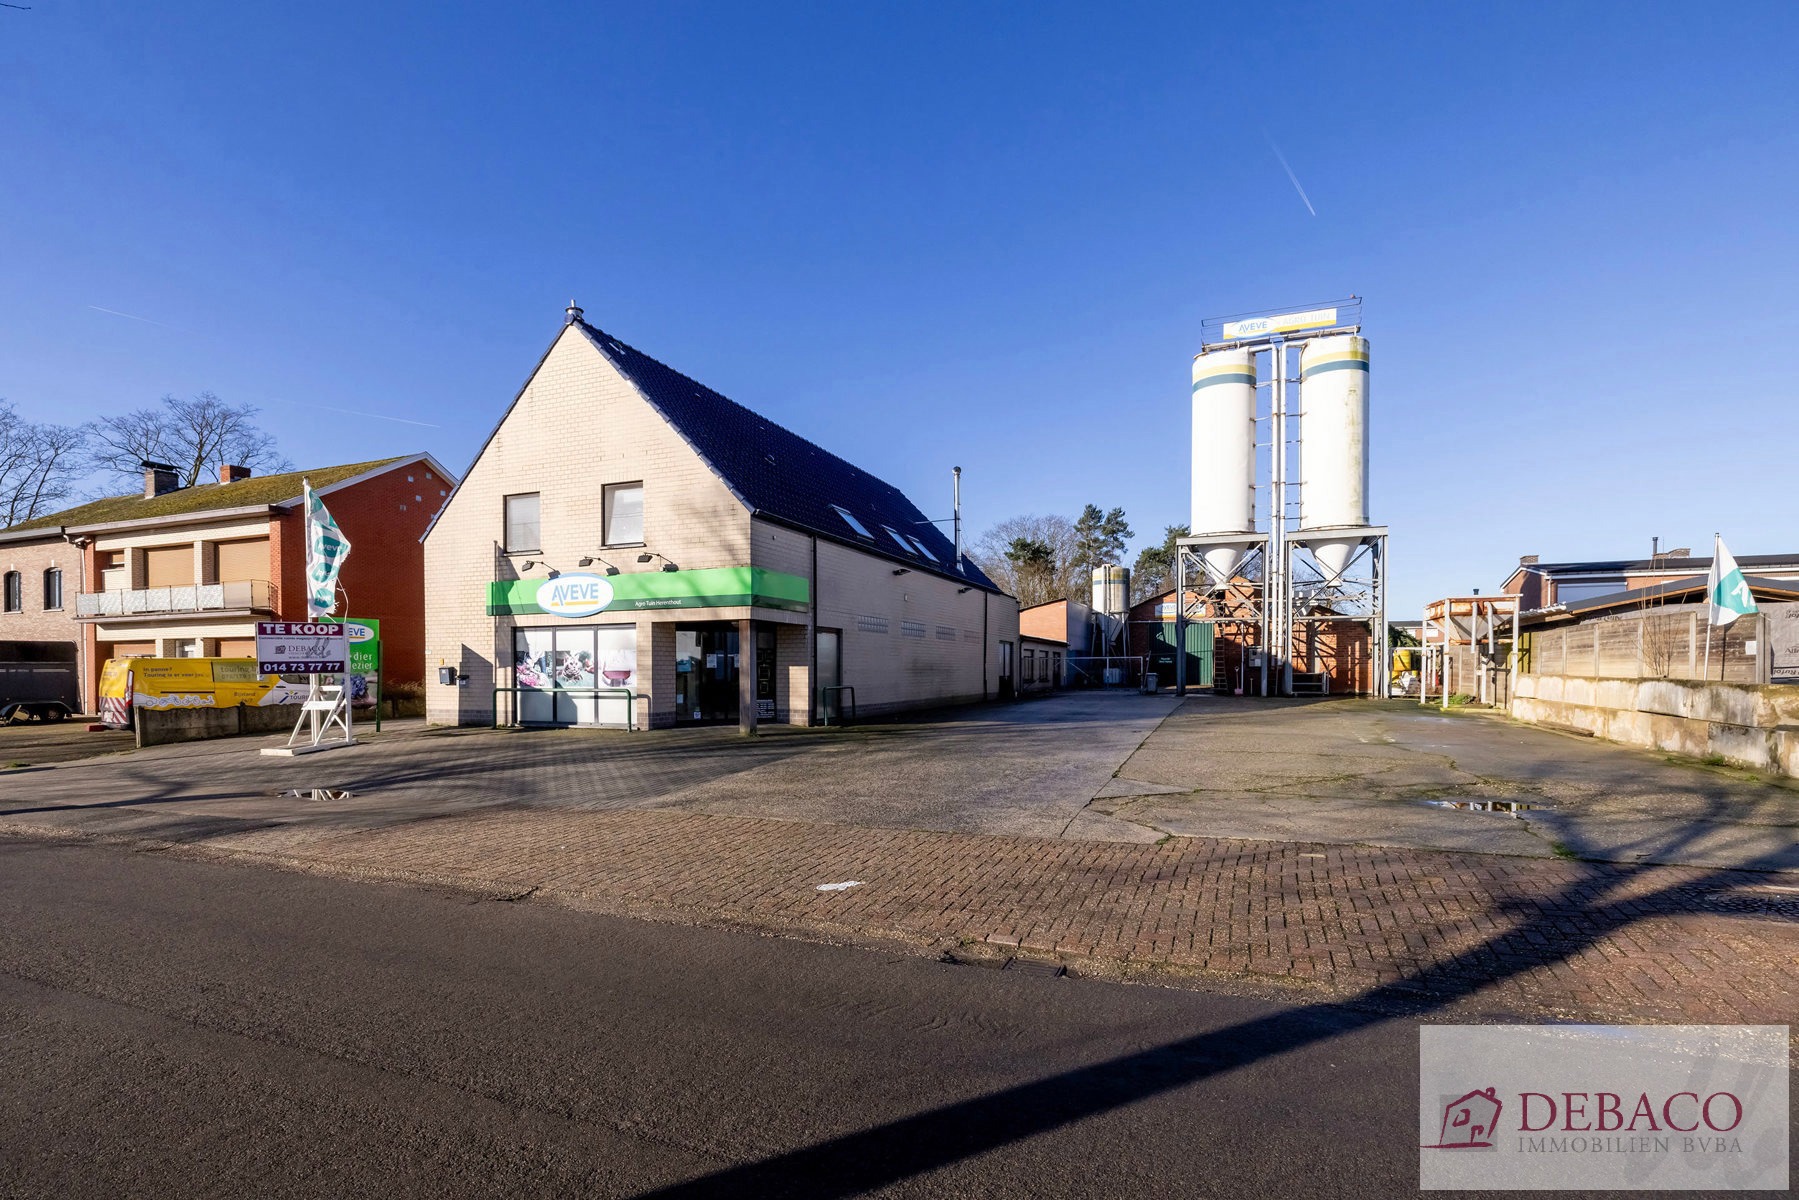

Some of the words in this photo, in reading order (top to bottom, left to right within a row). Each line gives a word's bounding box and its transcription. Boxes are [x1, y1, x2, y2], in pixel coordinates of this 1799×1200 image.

[1239, 321, 1268, 334] AVEVE
[552, 583, 599, 604] AVEVE
[262, 624, 286, 635] TE
[291, 624, 339, 635] KOOP
[348, 628, 366, 636] EVE
[288, 644, 325, 652] DEBACO
[353, 651, 373, 661] dier
[263, 663, 287, 672] 014
[290, 663, 305, 672] 73
[308, 663, 323, 671] 77
[326, 662, 341, 671] 77
[352, 662, 373, 670] ezier
